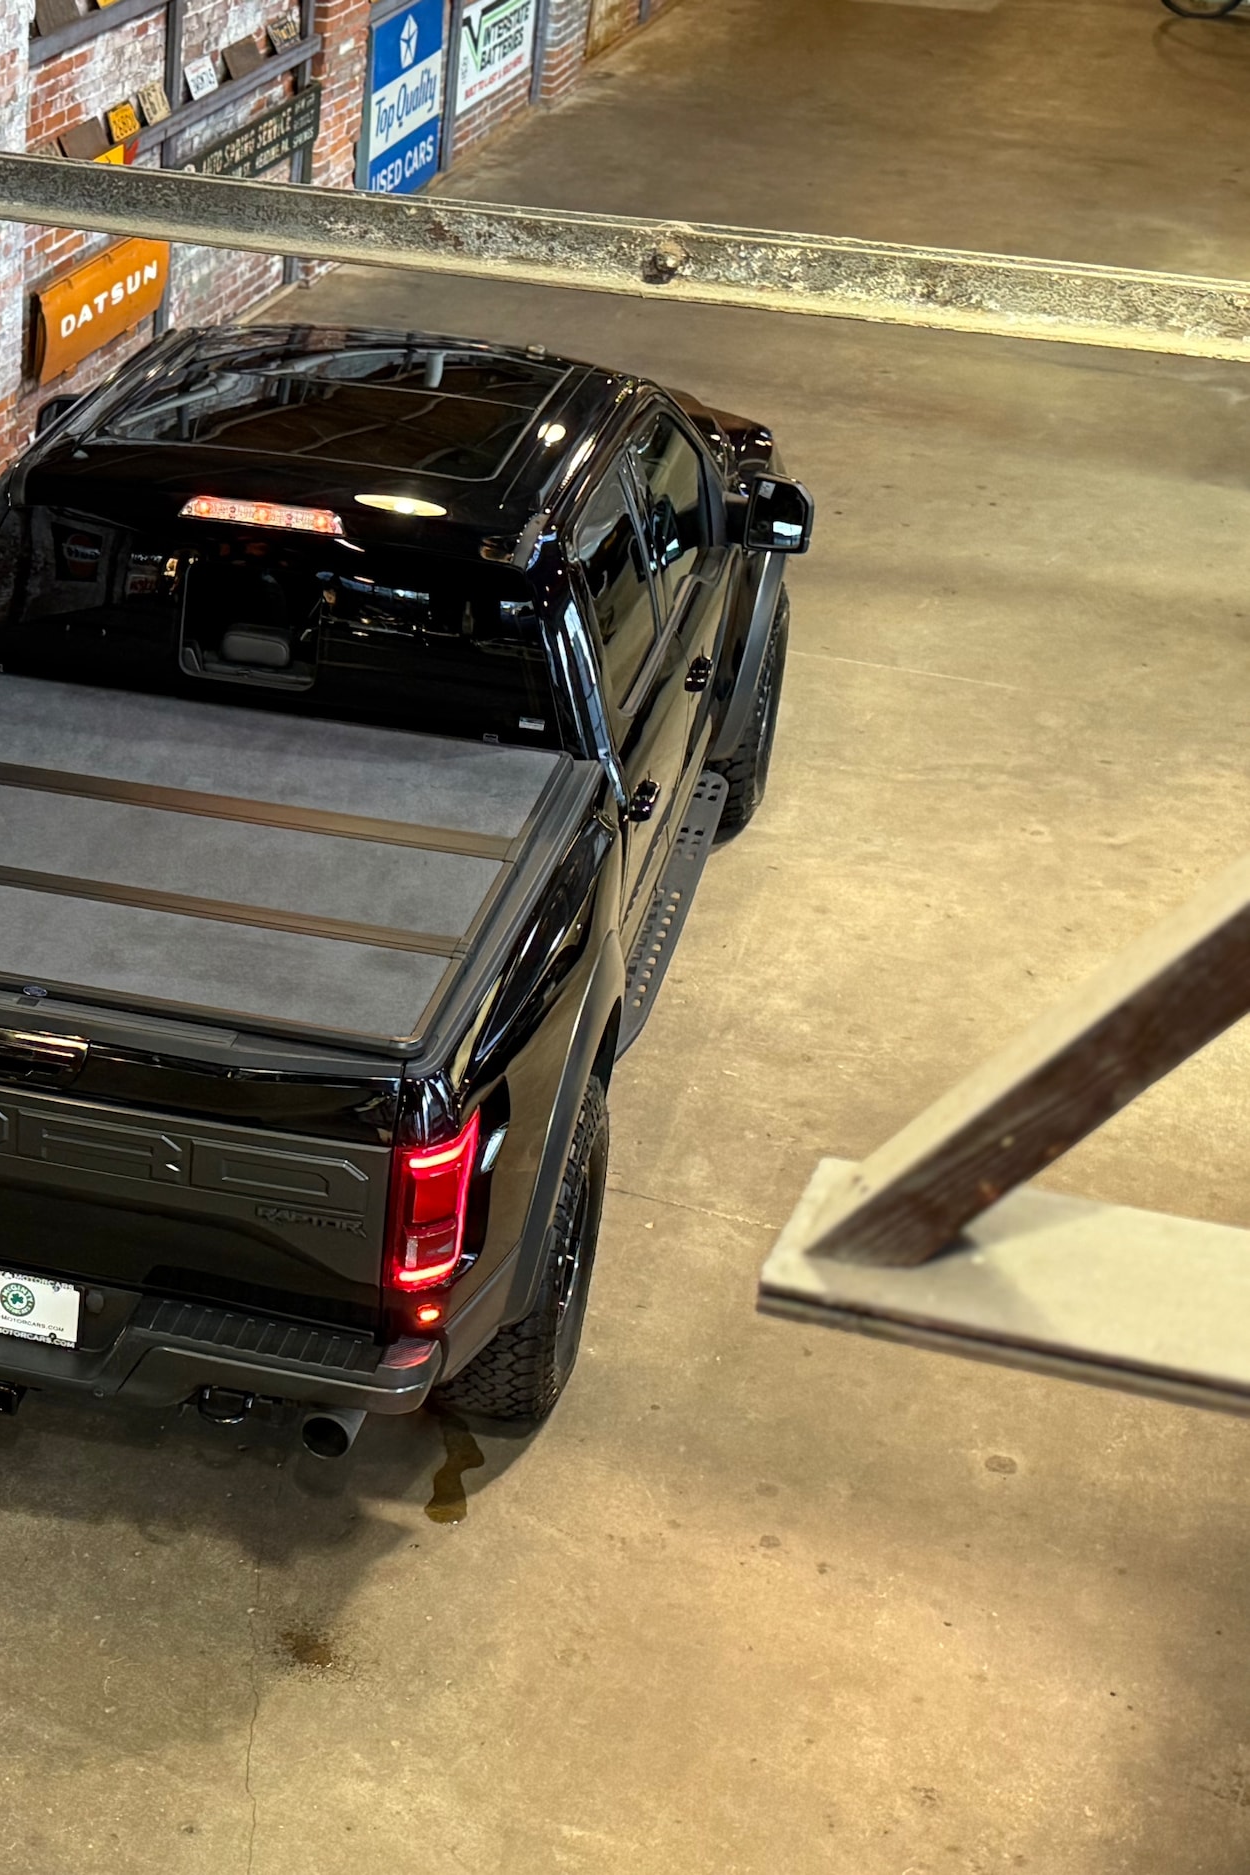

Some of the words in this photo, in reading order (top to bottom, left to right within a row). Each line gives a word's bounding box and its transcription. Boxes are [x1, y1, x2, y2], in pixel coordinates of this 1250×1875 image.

[480, 26, 524, 71] BATTERIES
[483, 1, 530, 47] INTERSTATE
[375, 96, 395, 143] Top
[396, 67, 437, 128] Quality
[224, 129, 256, 168] SPRING
[256, 107, 292, 149] SERVICE
[372, 157, 402, 193] USED
[404, 135, 435, 179] CARS
[60, 260, 157, 338] DATSUN
[255, 1205, 367, 1239] RAPTOR
